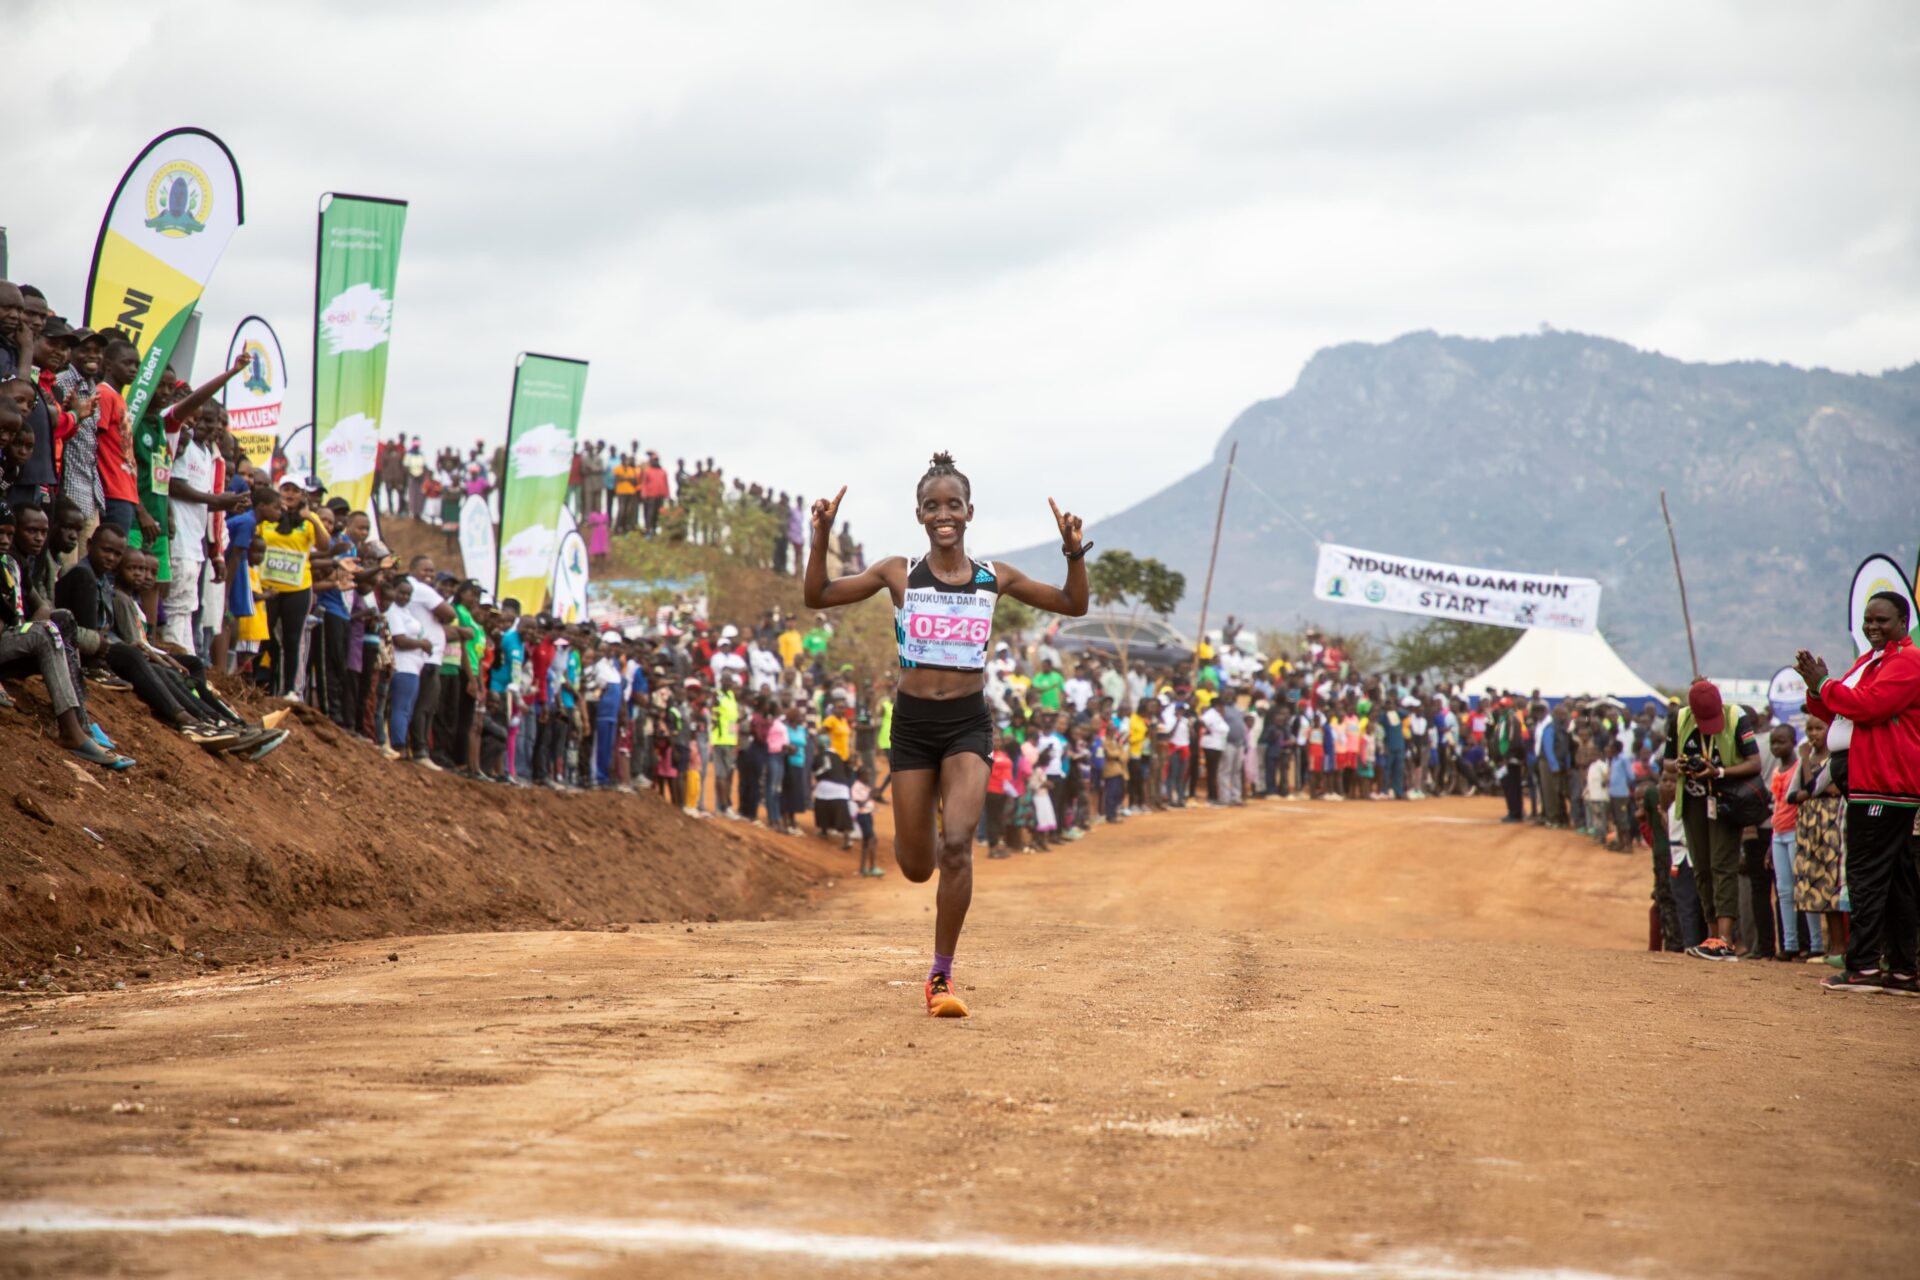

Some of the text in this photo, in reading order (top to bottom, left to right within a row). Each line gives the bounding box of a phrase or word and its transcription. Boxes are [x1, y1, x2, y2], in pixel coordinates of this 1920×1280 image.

[137, 346, 163, 386] Talent
[228, 404, 280, 428] MAKUENI
[268, 558, 299, 573] 0074
[1349, 555, 1569, 599] NDUKUMA DAM RUN
[907, 591, 954, 605] NDUKUMA
[957, 595, 976, 606] DAM
[1420, 591, 1489, 615] START
[915, 616, 987, 641] 0546
